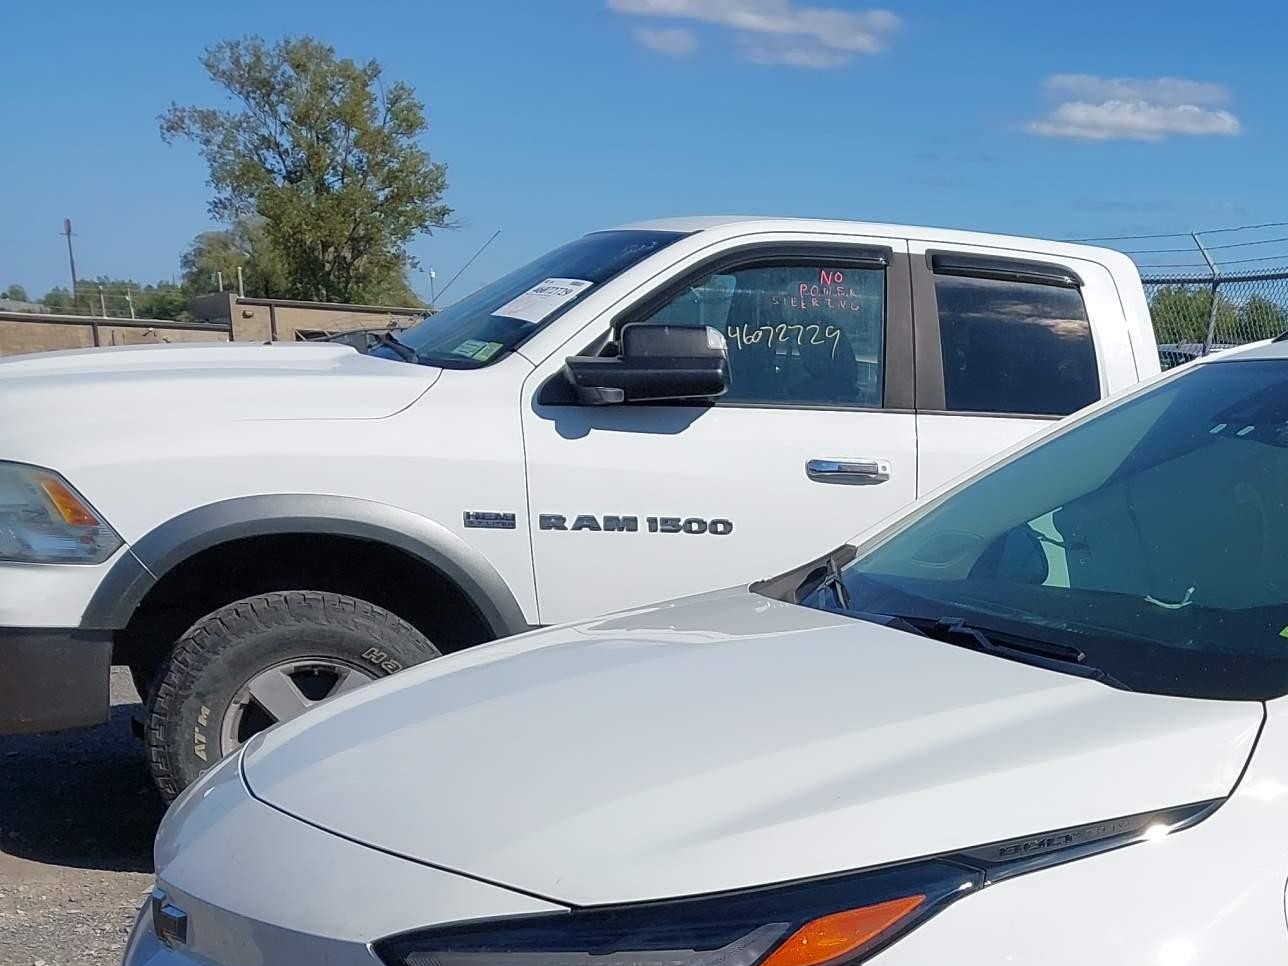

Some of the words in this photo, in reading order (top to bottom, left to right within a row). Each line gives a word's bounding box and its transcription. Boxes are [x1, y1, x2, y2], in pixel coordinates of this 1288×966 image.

[820, 270, 843, 285] NO
[727, 323, 841, 360] 46072729
[538, 513, 638, 532] RAM
[646, 516, 734, 535] 1500
